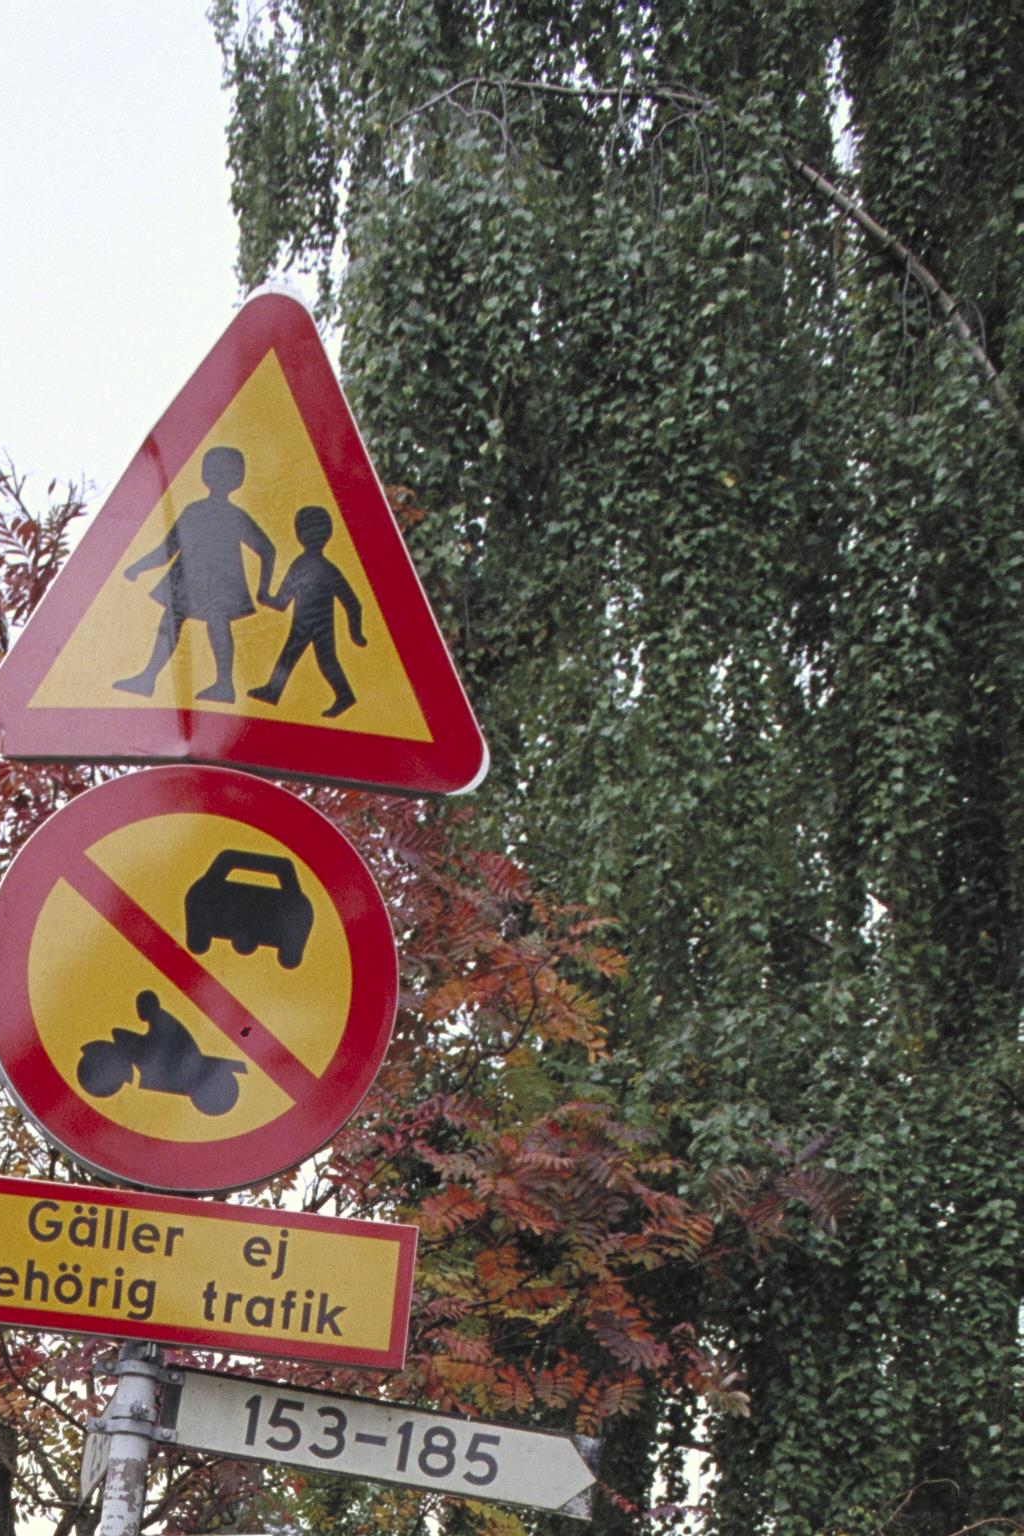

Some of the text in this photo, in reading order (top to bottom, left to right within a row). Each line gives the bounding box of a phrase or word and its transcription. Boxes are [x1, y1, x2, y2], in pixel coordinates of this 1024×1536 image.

[27, 1200, 288, 1280] Gäller ej
[202, 1279, 346, 1337] trafik
